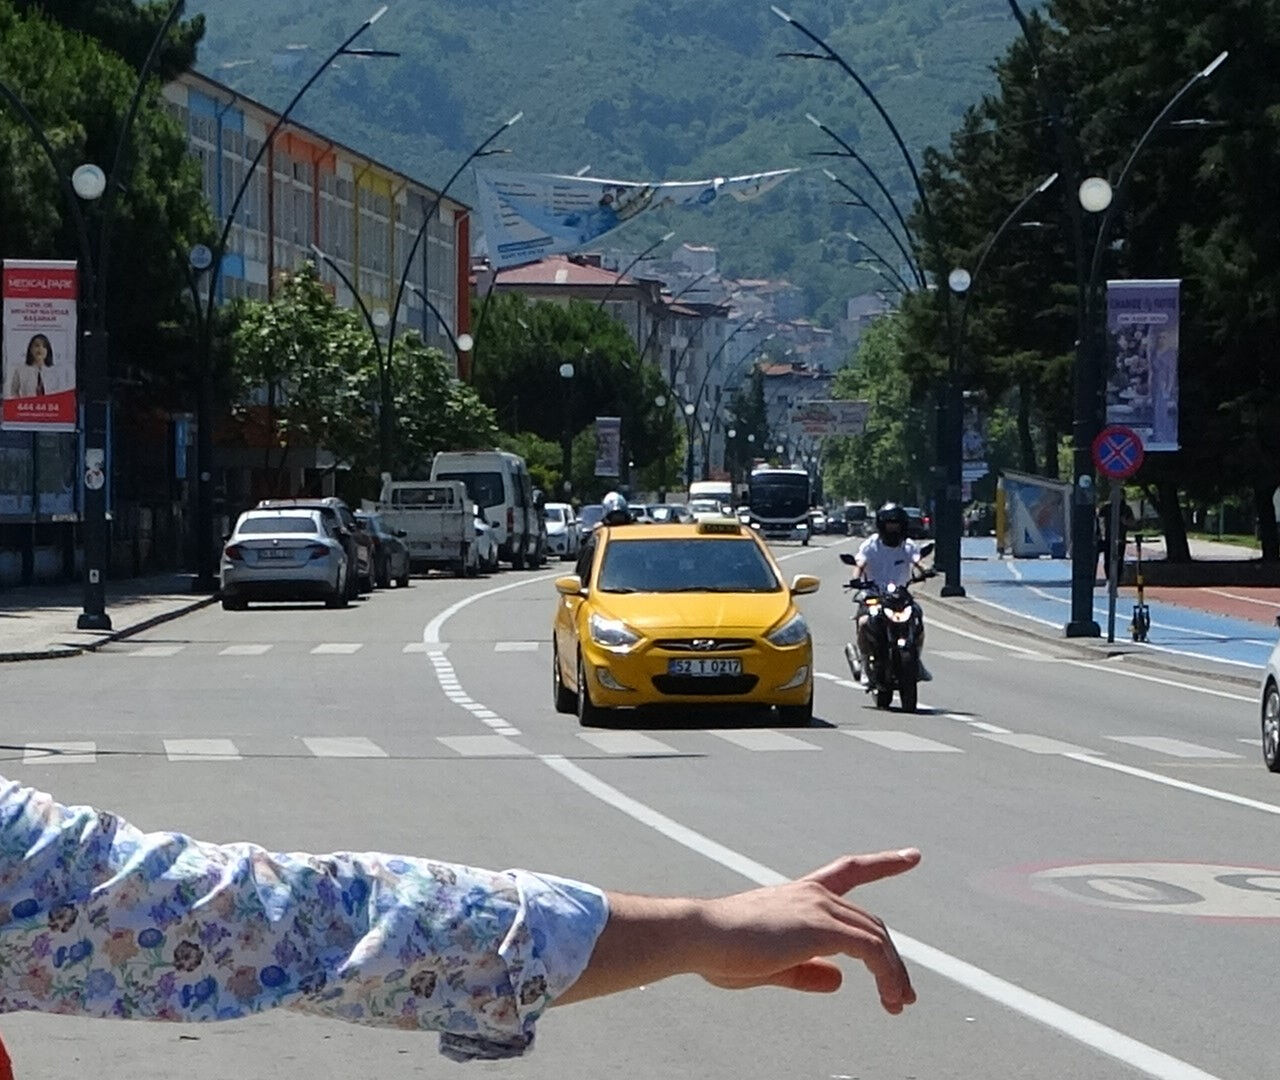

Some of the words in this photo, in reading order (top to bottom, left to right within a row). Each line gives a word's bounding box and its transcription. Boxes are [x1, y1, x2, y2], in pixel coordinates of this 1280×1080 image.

[677, 661, 692, 672] 52
[699, 661, 707, 673] T
[711, 661, 740, 673] 0217
